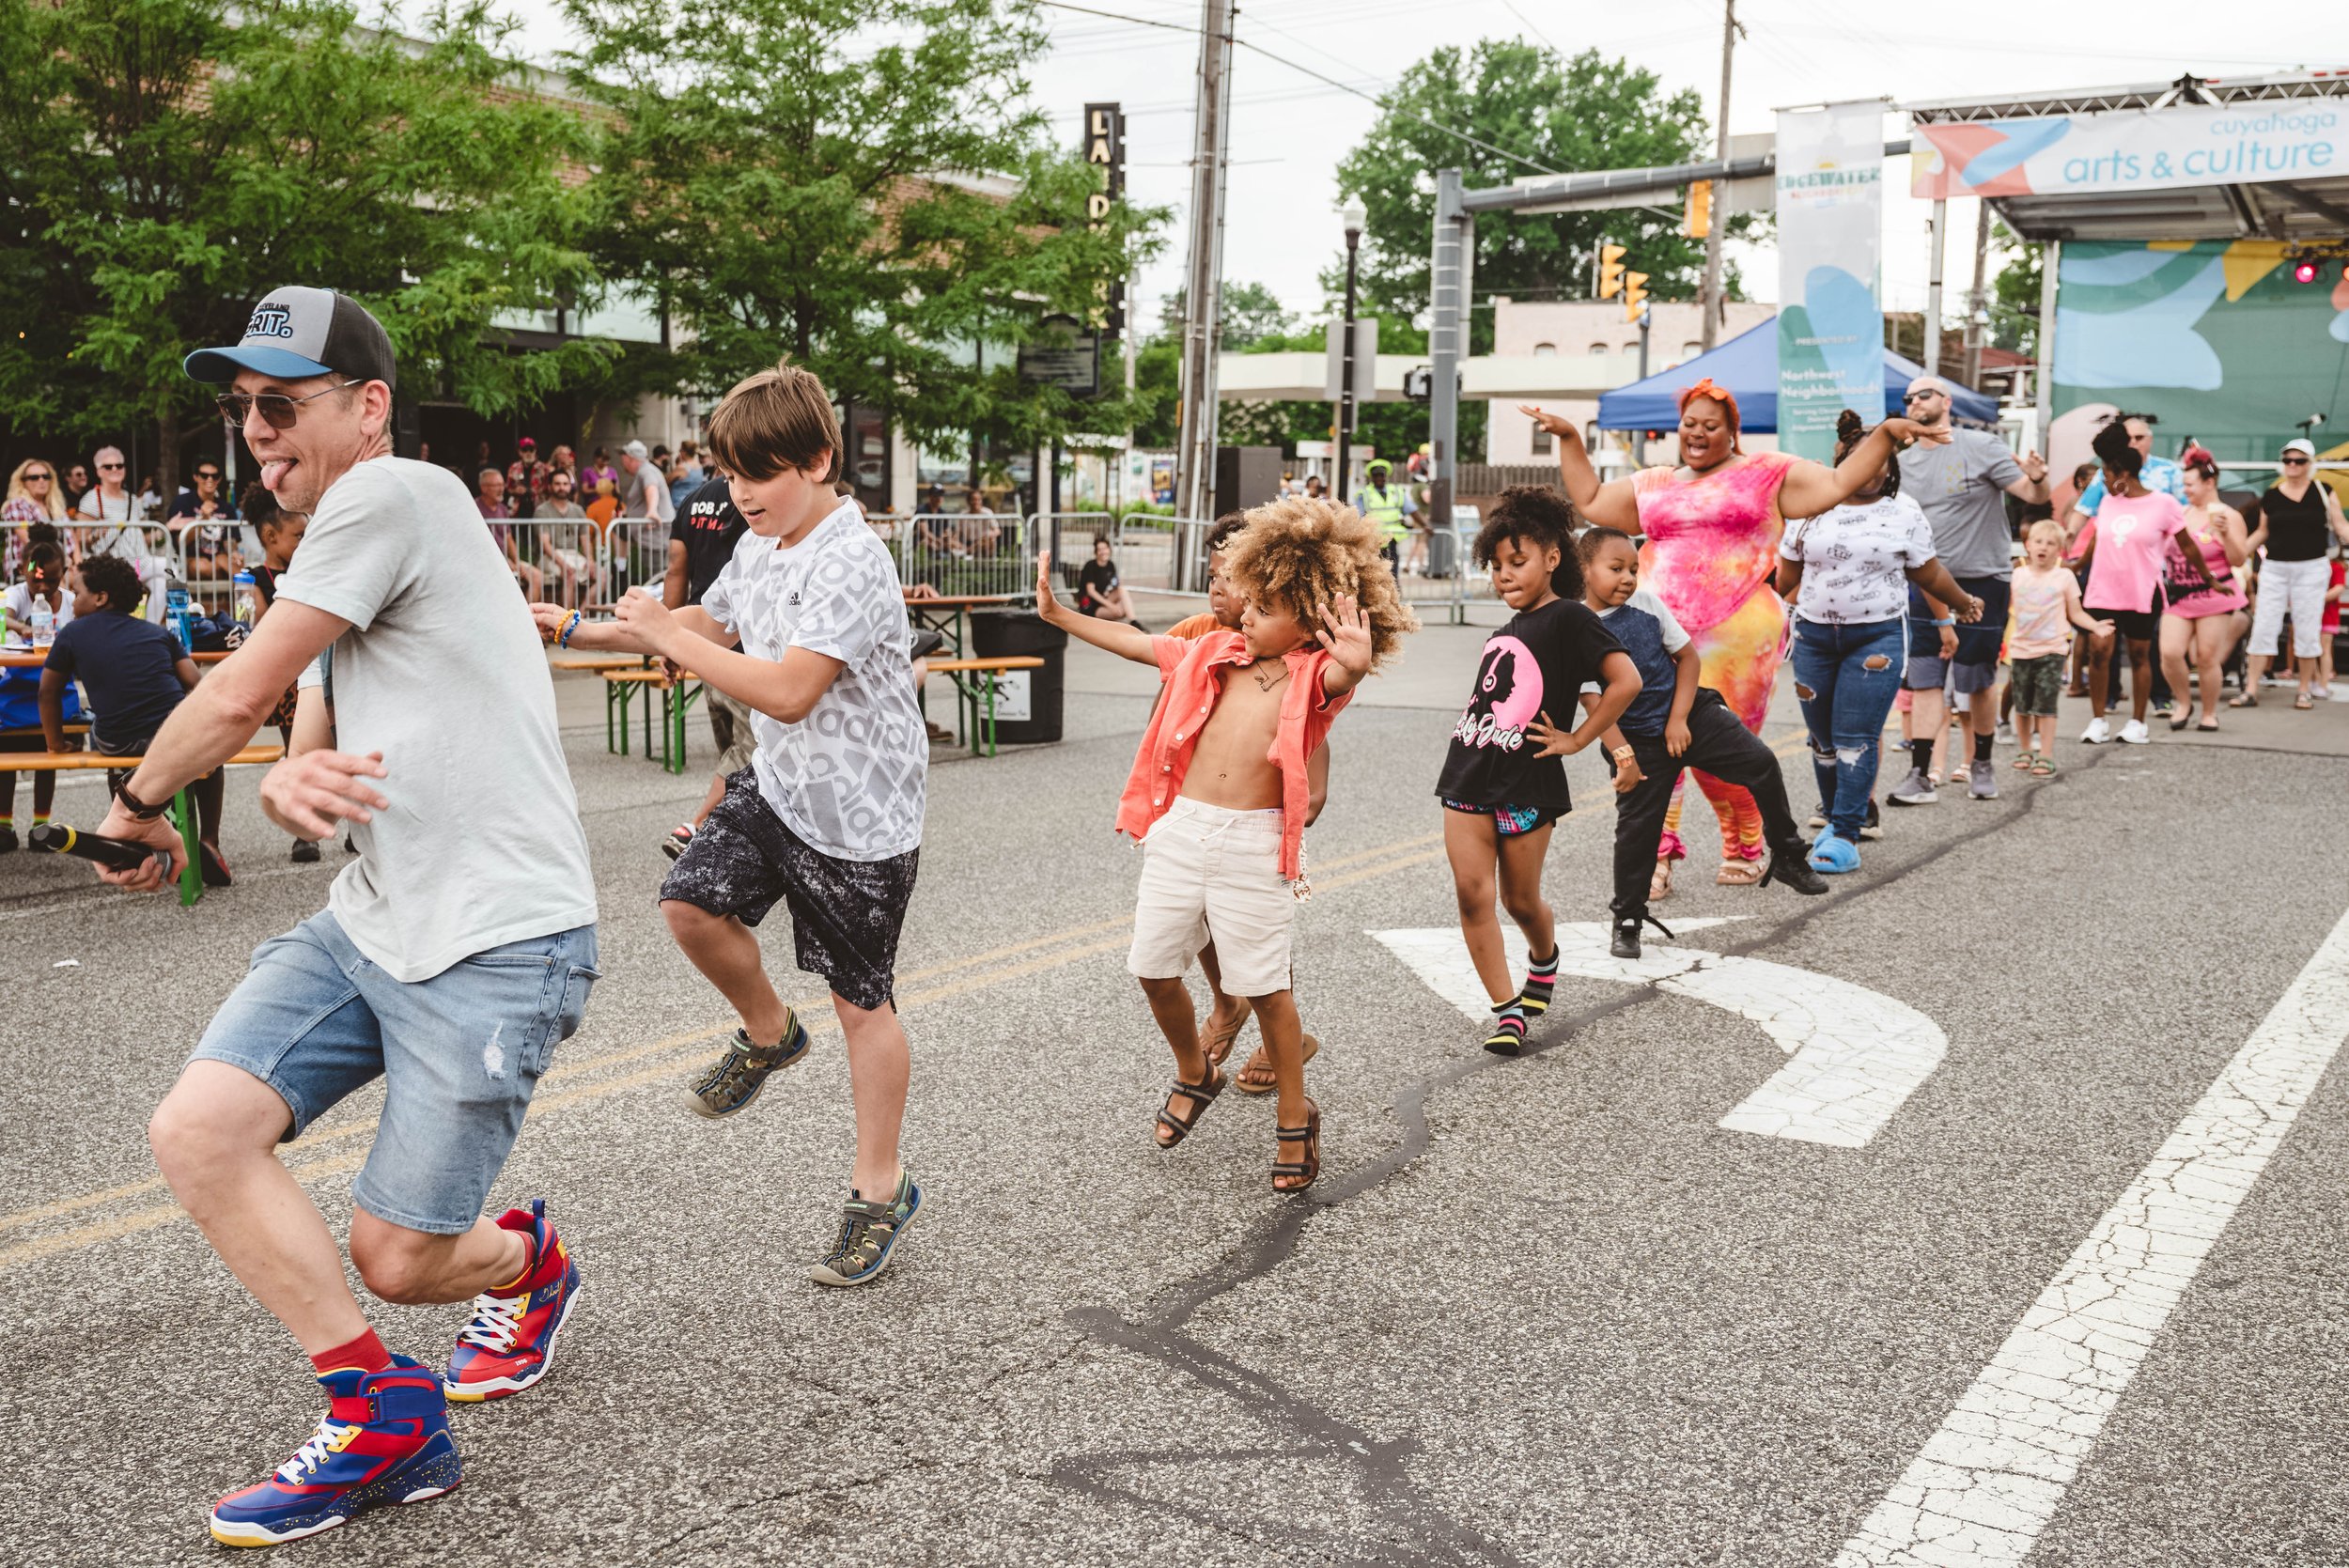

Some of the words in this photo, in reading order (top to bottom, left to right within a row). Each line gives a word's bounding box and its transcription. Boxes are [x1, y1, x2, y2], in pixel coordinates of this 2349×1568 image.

[2210, 112, 2338, 137] cuyahoga
[2063, 149, 2141, 184] arts
[2150, 151, 2174, 179] &
[2184, 141, 2335, 177] culture
[1781, 368, 1845, 381] Northwest
[1781, 382, 1879, 400] Neighborhoods
